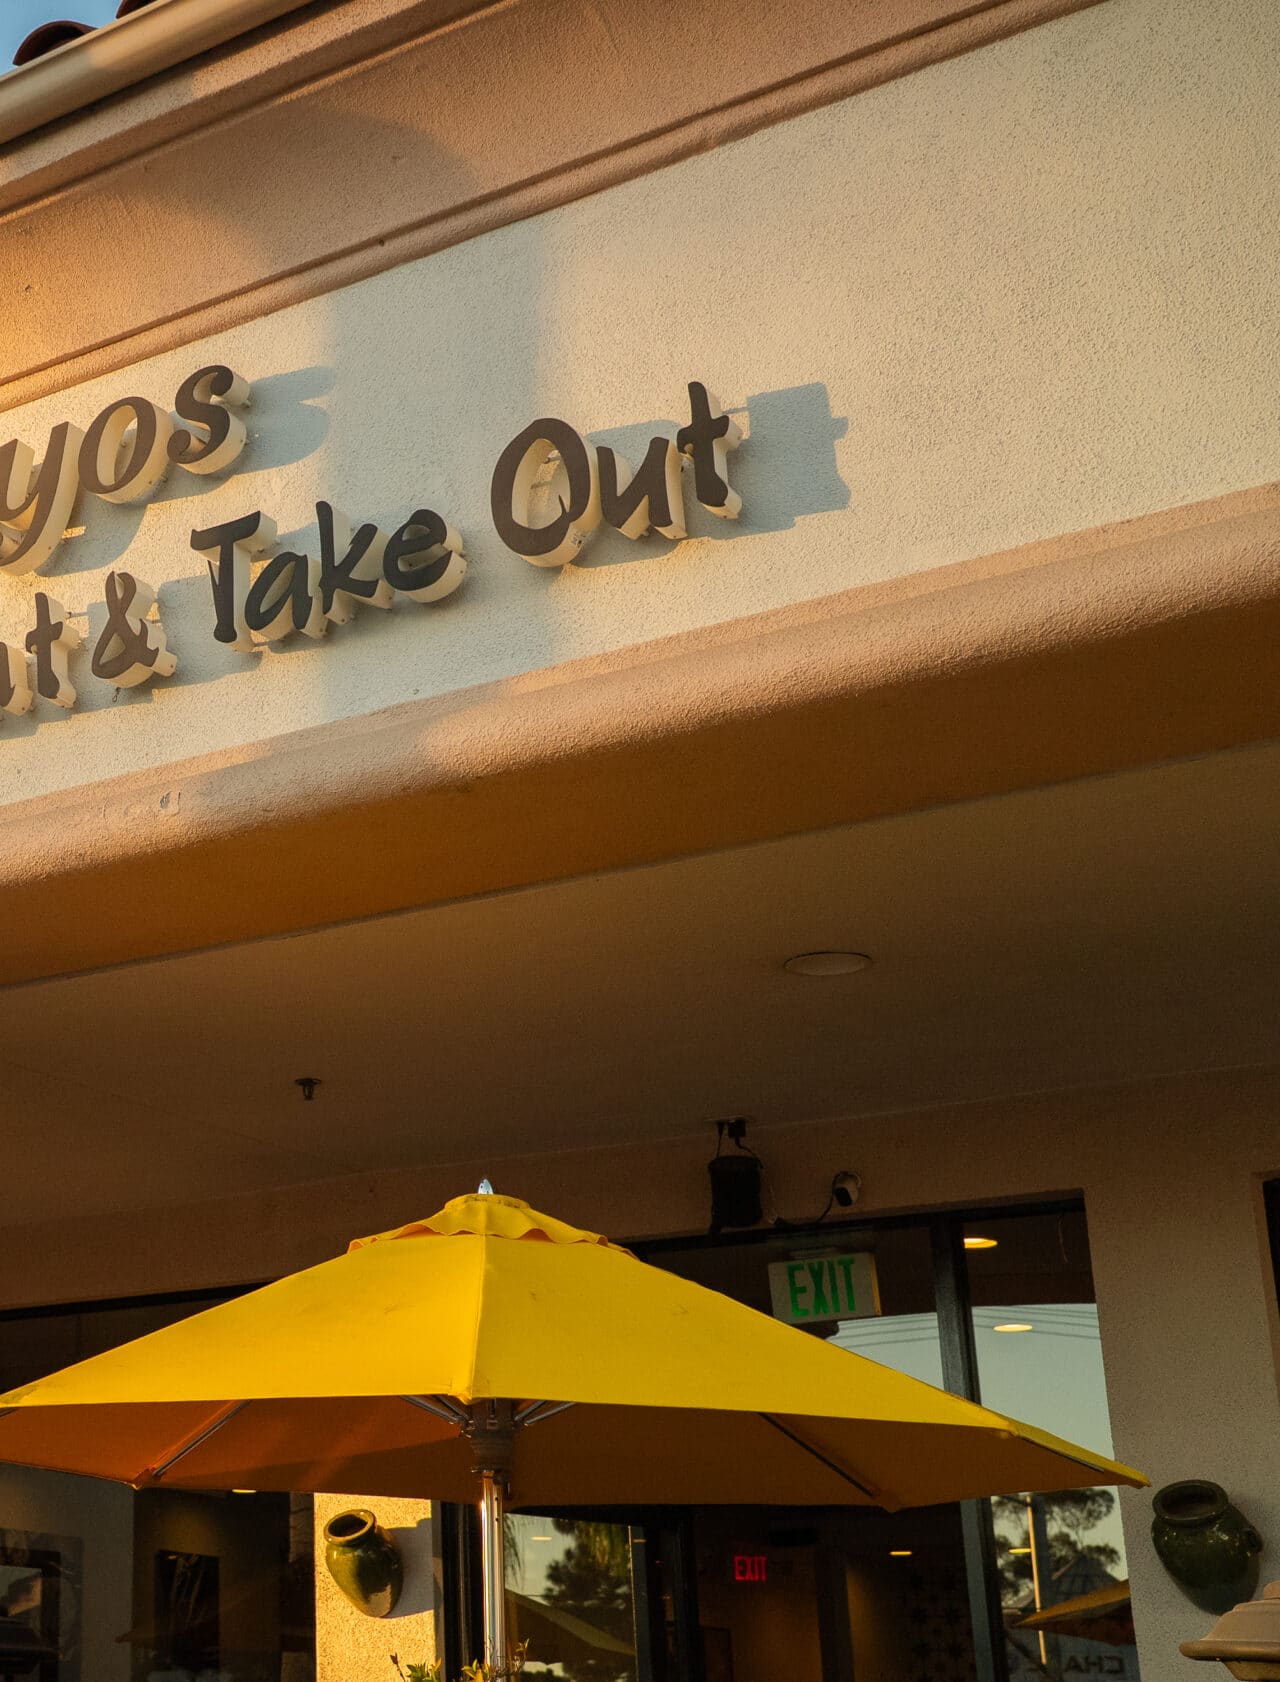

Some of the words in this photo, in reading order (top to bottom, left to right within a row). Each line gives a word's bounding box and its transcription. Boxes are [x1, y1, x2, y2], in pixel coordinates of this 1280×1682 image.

[91, 571, 168, 683] &
[191, 500, 460, 645] Take
[491, 381, 736, 559] Out
[786, 1256, 856, 1318] EXIT
[734, 1555, 767, 1581] EXIT
